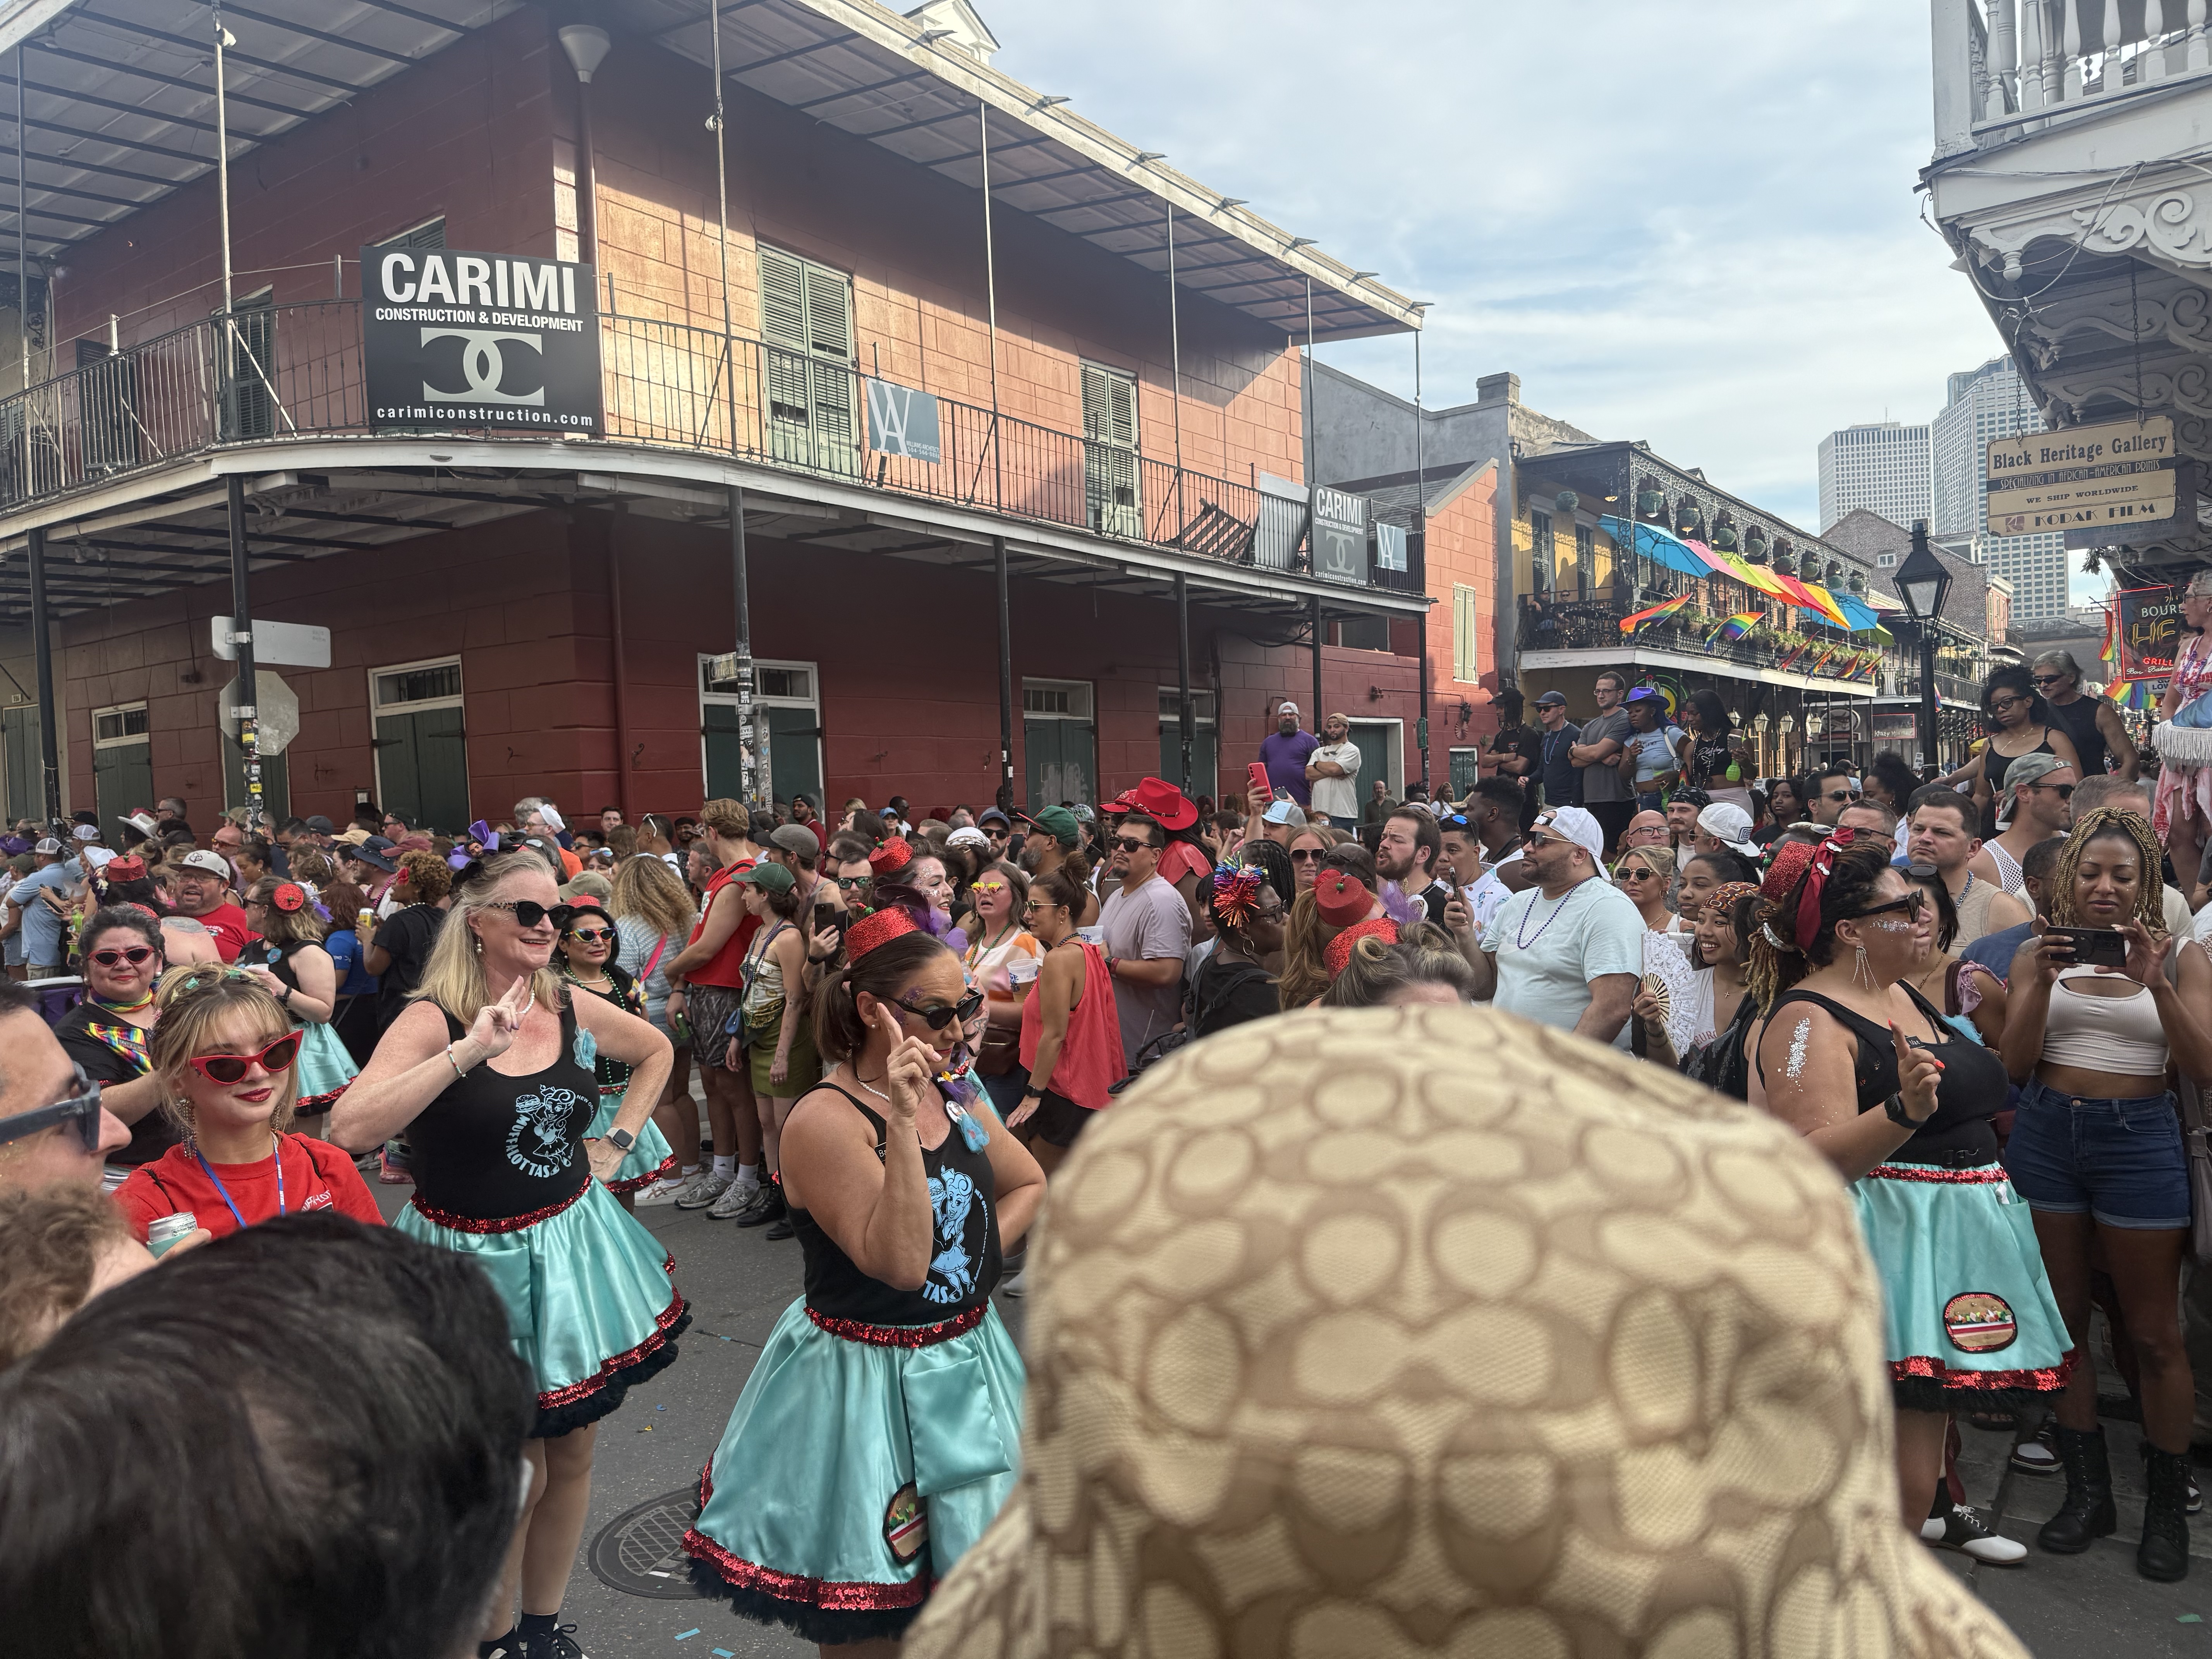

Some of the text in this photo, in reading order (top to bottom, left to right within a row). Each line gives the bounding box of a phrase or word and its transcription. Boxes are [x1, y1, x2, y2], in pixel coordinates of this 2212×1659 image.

[381, 253, 576, 314] CARIMI
[376, 308, 583, 332] CONSTRUCTION & DEVELOPMENT
[377, 406, 593, 426] carimiconstruction.com
[1993, 435, 2167, 470] Black Heritage Gallery
[2000, 474, 2044, 490] SPECIALIZING
[2048, 473, 2055, 483] IN
[2135, 459, 2160, 472] PRINTS
[2047, 493, 2070, 501] SHIP
[2076, 485, 2138, 498] WORLDWIDE
[1316, 488, 1362, 526] CARIMI
[2035, 503, 2156, 527] KODAK FILM
[1315, 517, 1339, 530] CONSTRUCTION
[1342, 524, 1364, 535] DEVELOPMENT
[1315, 571, 1367, 586] carimiconstruction.com
[2143, 657, 2174, 666] GRILL
[576, 1094, 589, 1103] NEW
